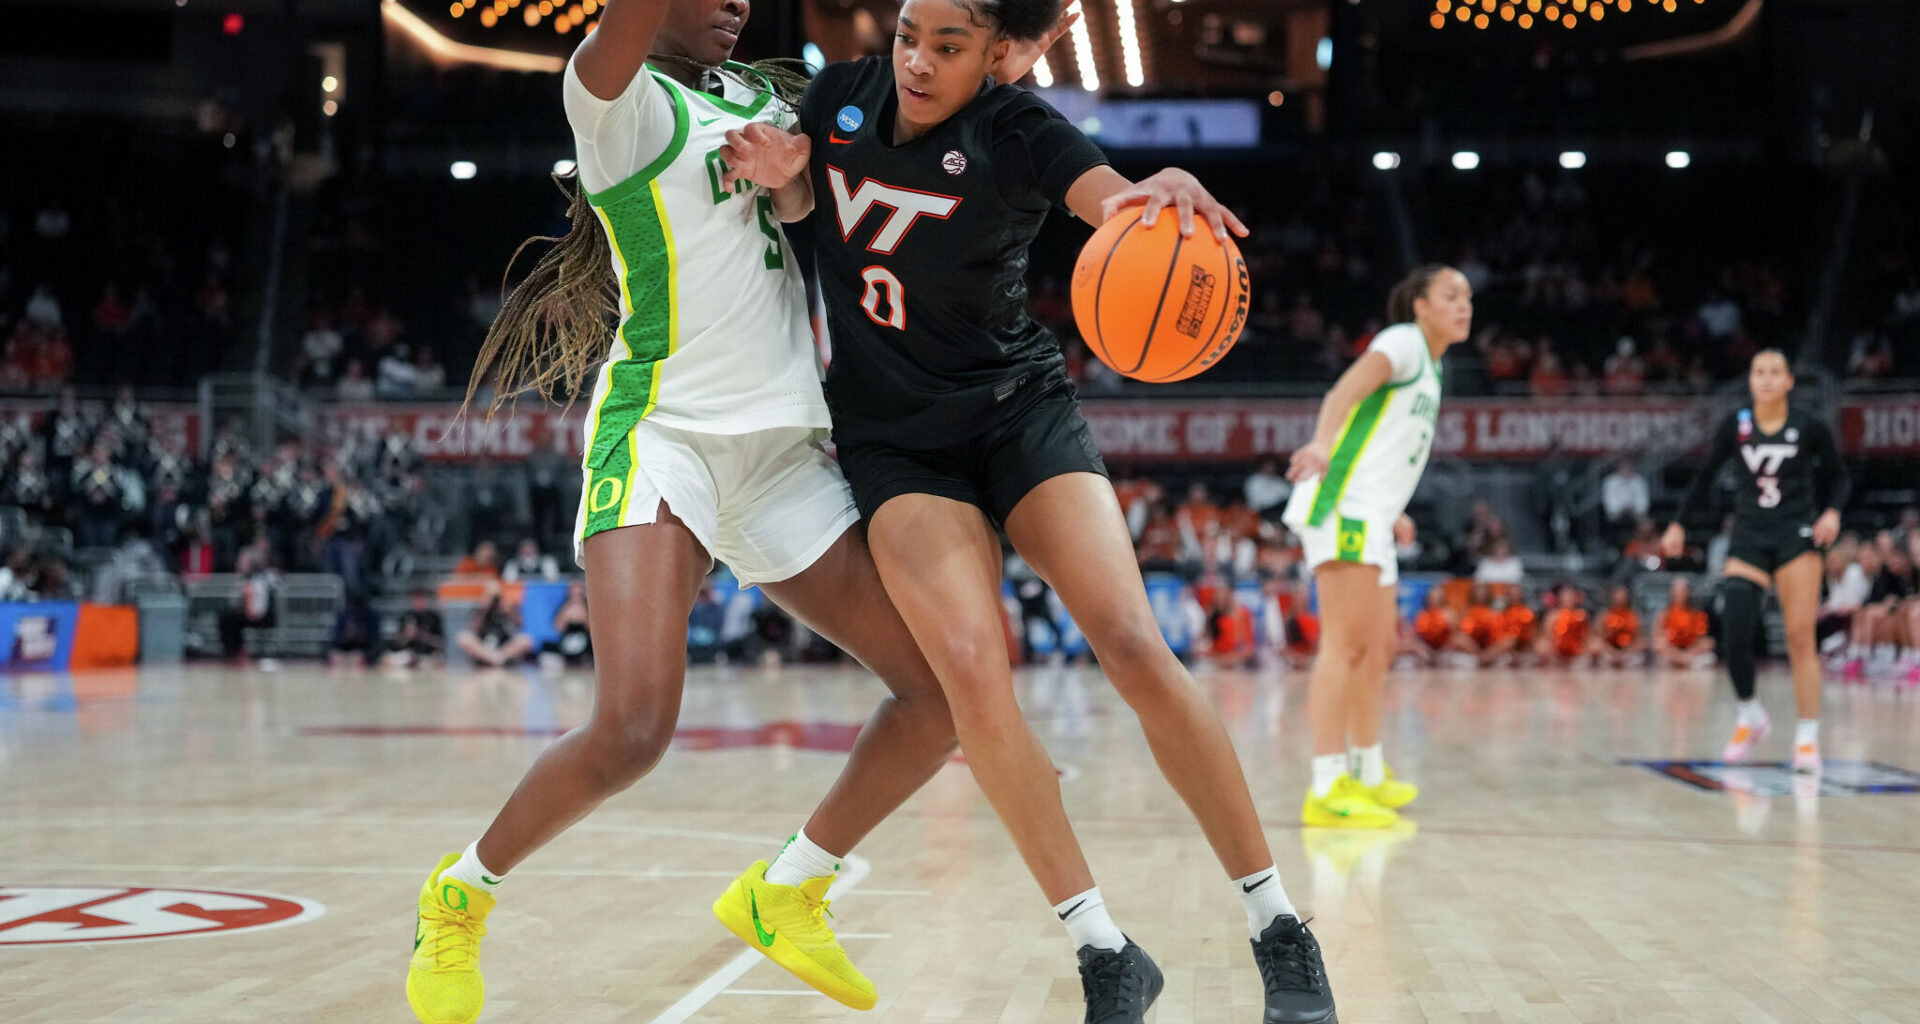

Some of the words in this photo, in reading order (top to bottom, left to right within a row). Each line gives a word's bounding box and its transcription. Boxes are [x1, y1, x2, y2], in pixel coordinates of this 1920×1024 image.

[839, 113, 859, 130] NCAA
[826, 162, 964, 256] VT
[860, 264, 906, 331] 0
[1087, 413, 1181, 455] OME
[1187, 413, 1235, 455] OF
[1863, 408, 1920, 449] HO
[1740, 443, 1798, 475] VT
[590, 477, 623, 513] O
[1756, 476, 1781, 508] 3
